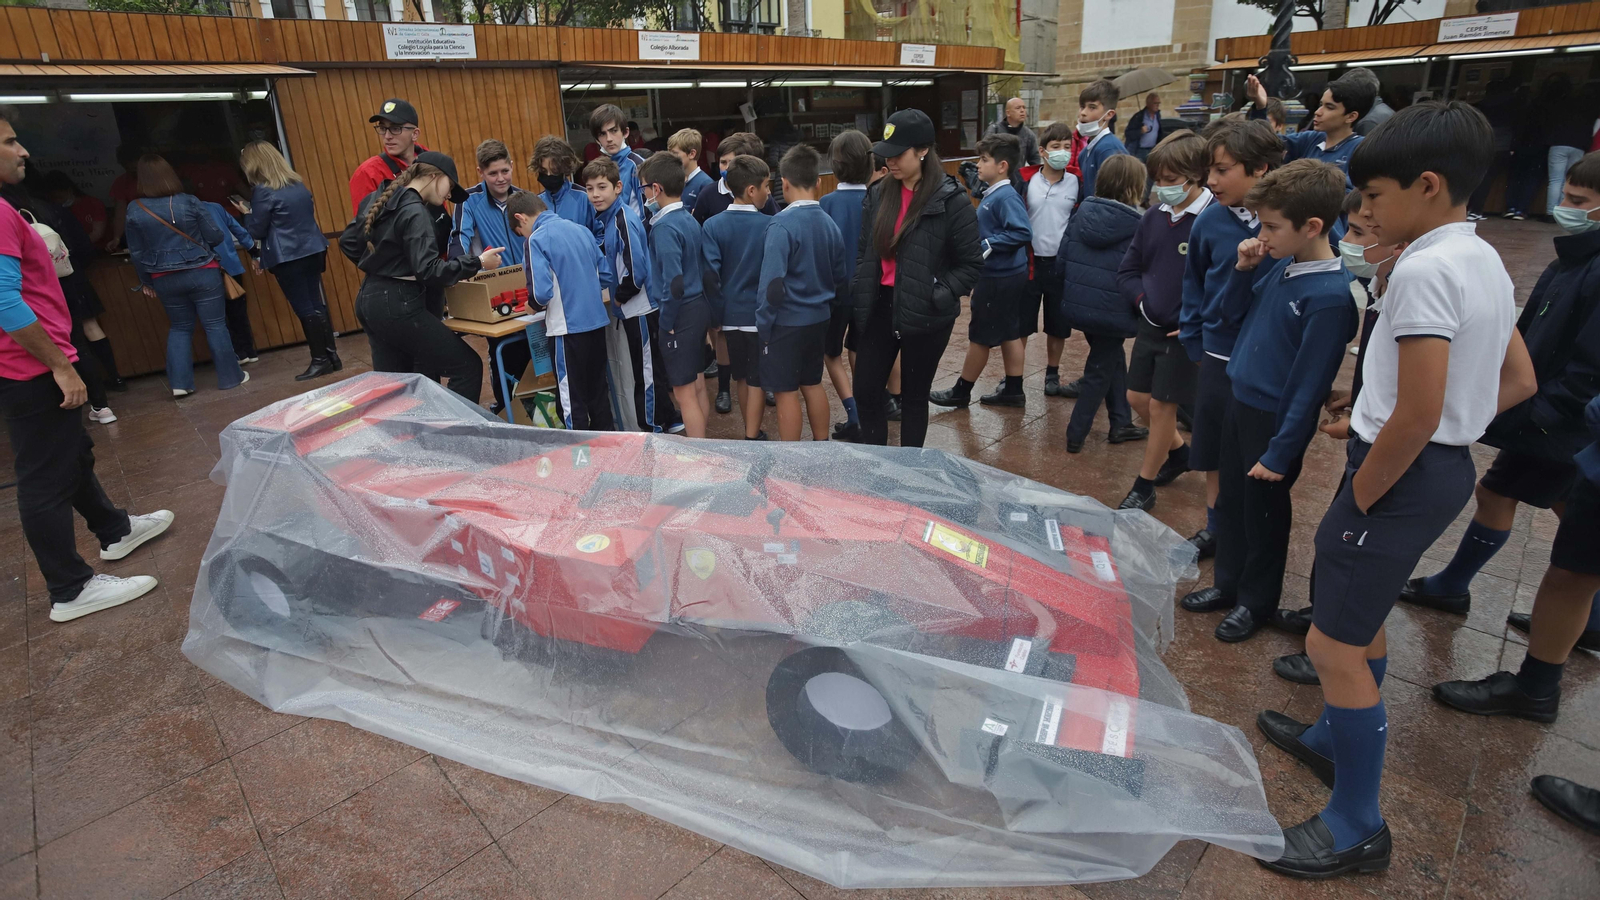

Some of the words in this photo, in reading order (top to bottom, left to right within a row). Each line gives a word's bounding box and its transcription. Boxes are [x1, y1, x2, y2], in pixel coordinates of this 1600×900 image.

[417, 44, 433, 52] Loyola
[473, 272, 496, 282] ANTONIO
[498, 266, 523, 277] MACHADO
